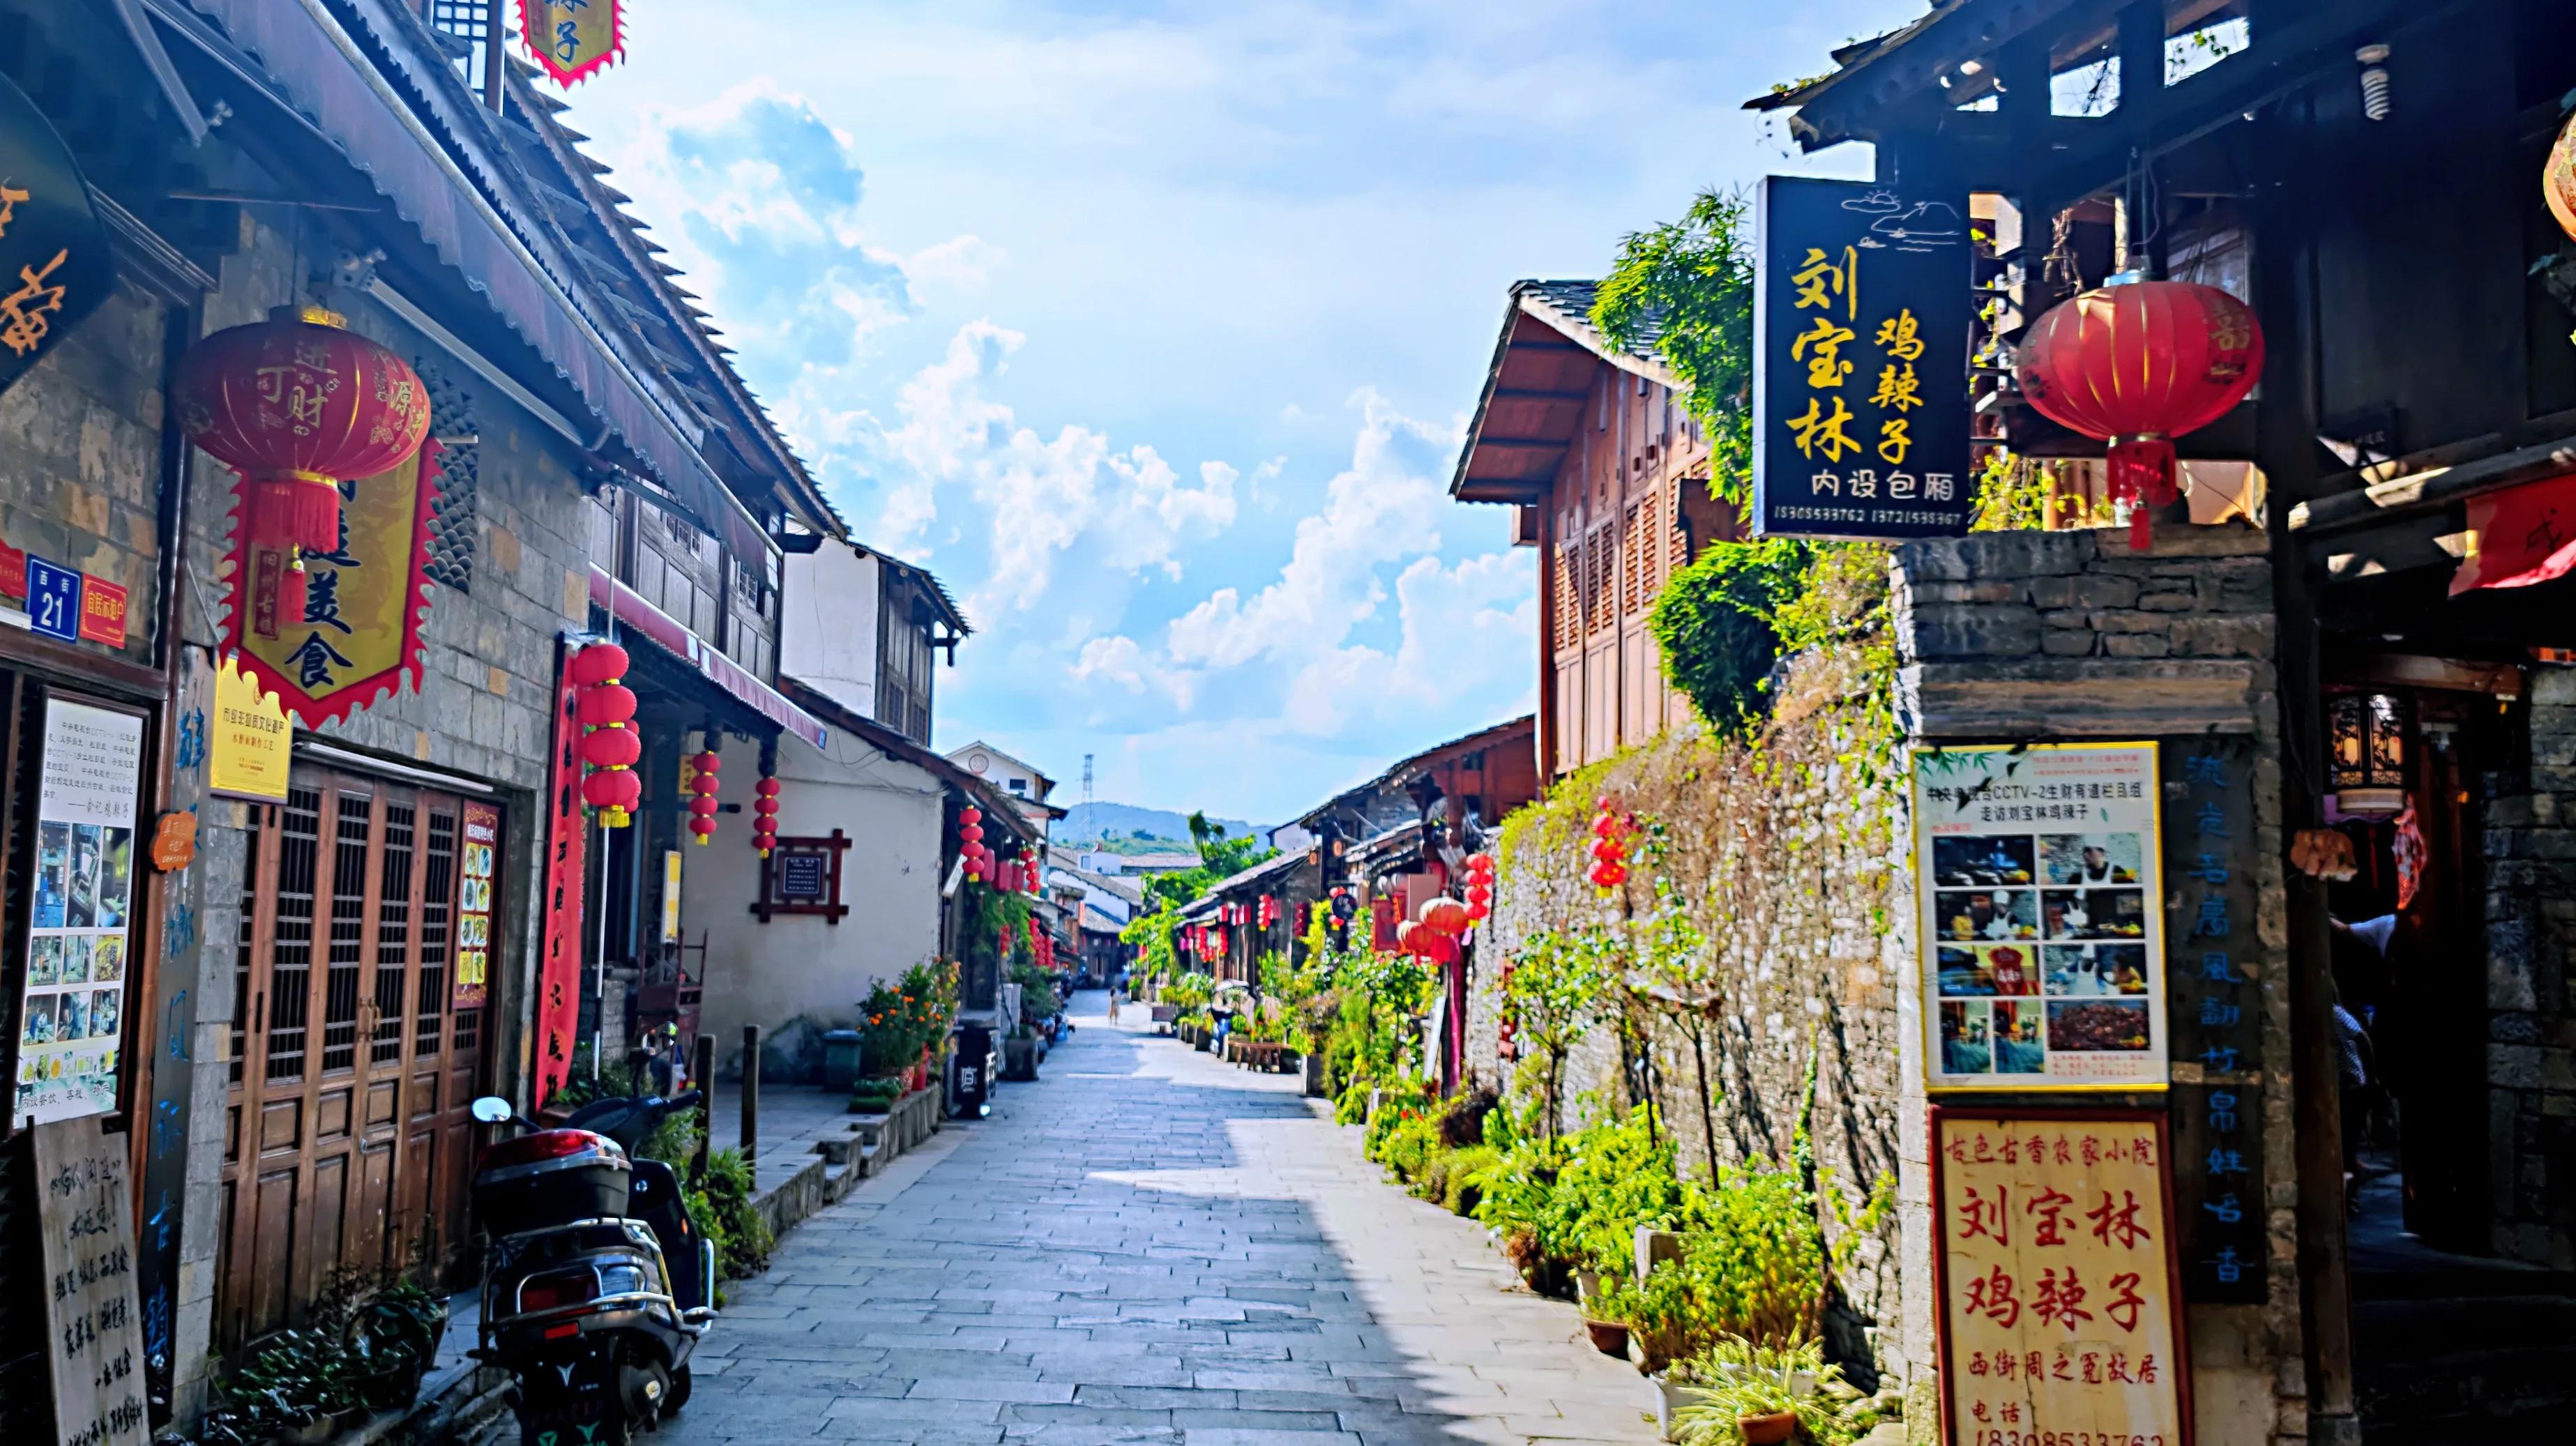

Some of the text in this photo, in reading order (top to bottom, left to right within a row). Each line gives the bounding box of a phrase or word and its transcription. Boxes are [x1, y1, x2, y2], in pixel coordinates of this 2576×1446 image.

[1786, 245, 1862, 464] 刘宝林
[1868, 308, 1925, 465] 鸡辣子
[1811, 469, 1955, 501] 内设包厢
[40, 570, 70, 593] 西街
[41, 592, 63, 630] 21
[1980, 803, 2089, 821] 走访刘宝林鸡辣子
[1944, 1132, 2158, 1167] 古色古香农家小院
[1957, 1184, 2152, 1251] 刘宝林
[1962, 1263, 2146, 1333] 鸡辣子
[1971, 1399, 2021, 1424] 电话
